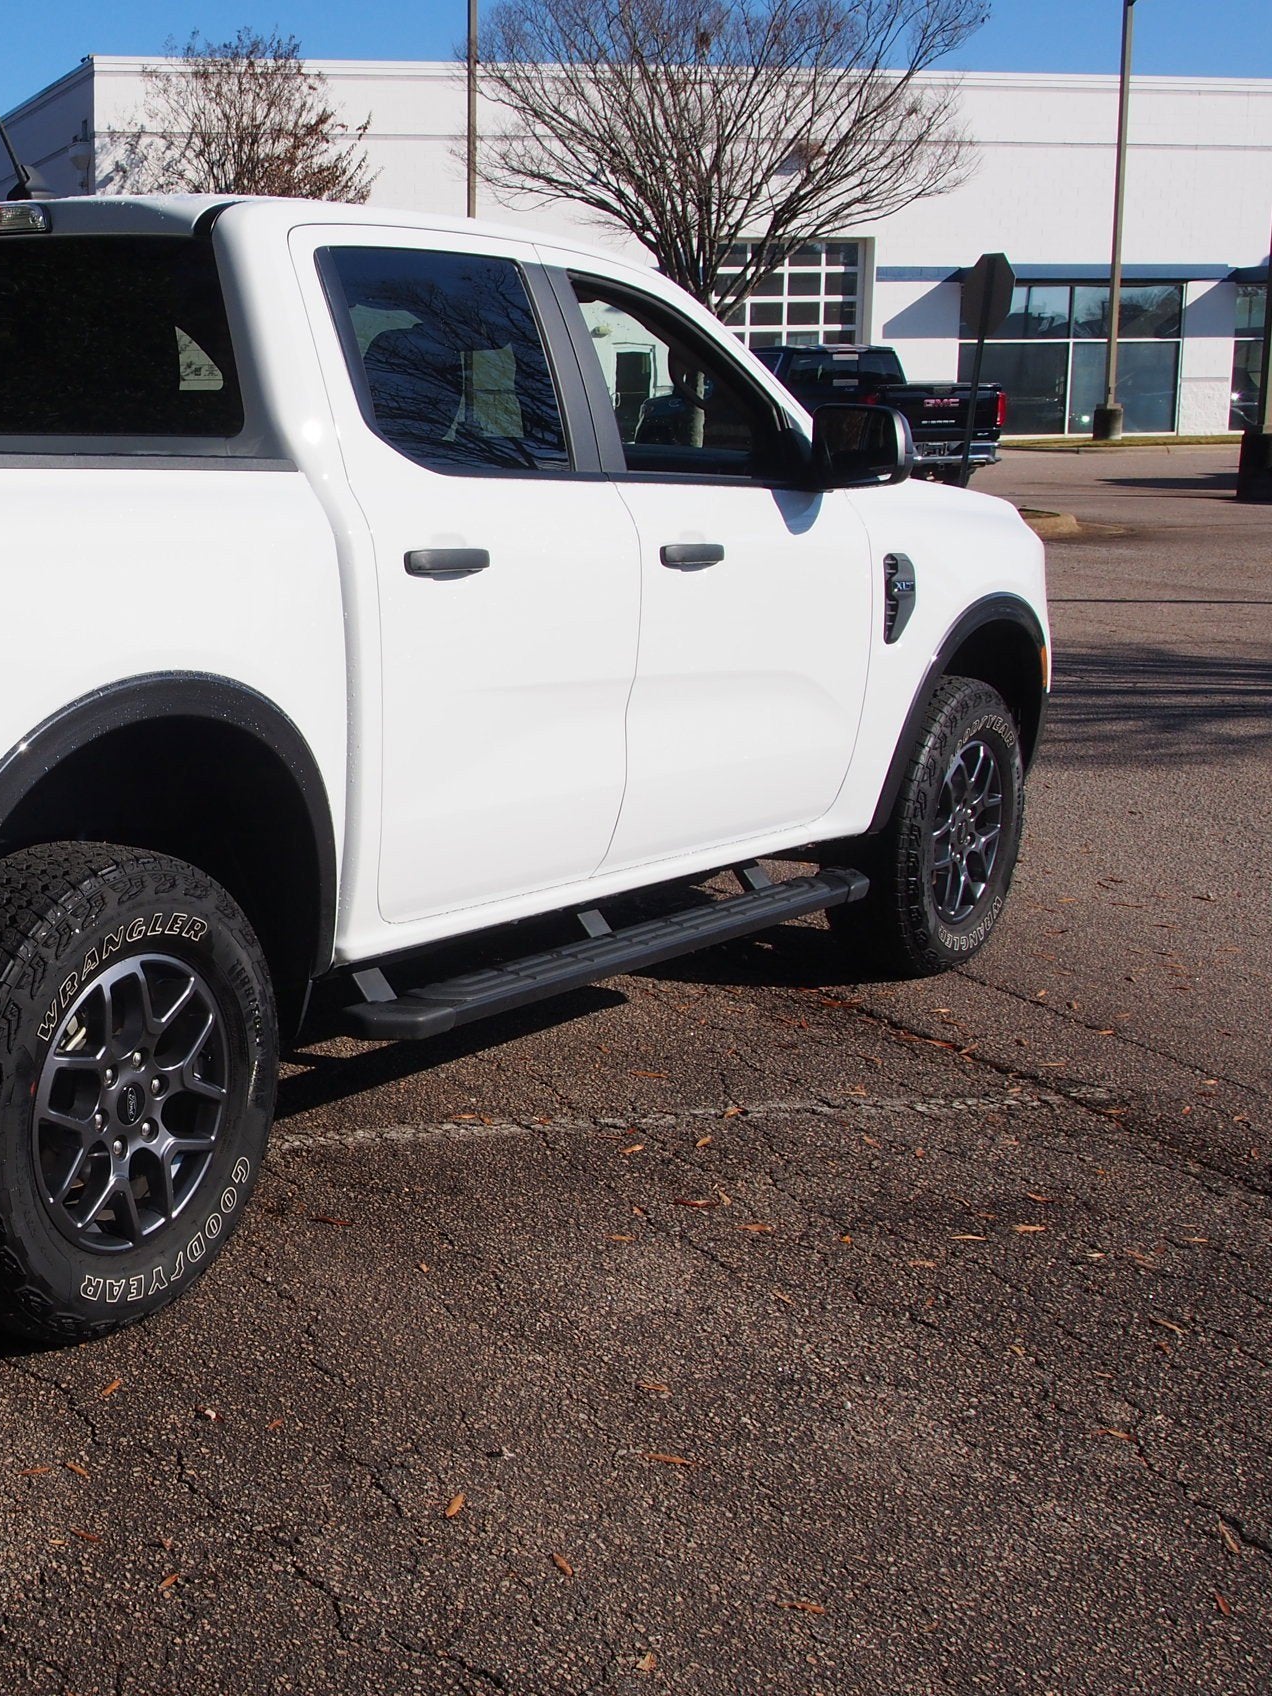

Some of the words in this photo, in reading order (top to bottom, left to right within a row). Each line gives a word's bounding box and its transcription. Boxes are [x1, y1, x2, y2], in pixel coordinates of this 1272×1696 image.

[923, 398, 960, 408] GMC
[893, 581, 915, 592] XLT
[950, 714, 1016, 757] OODYEAR
[938, 896, 1003, 952] WRANGLER
[36, 912, 209, 1042] WRANGLER
[80, 1156, 251, 1303] GOODYEAR
